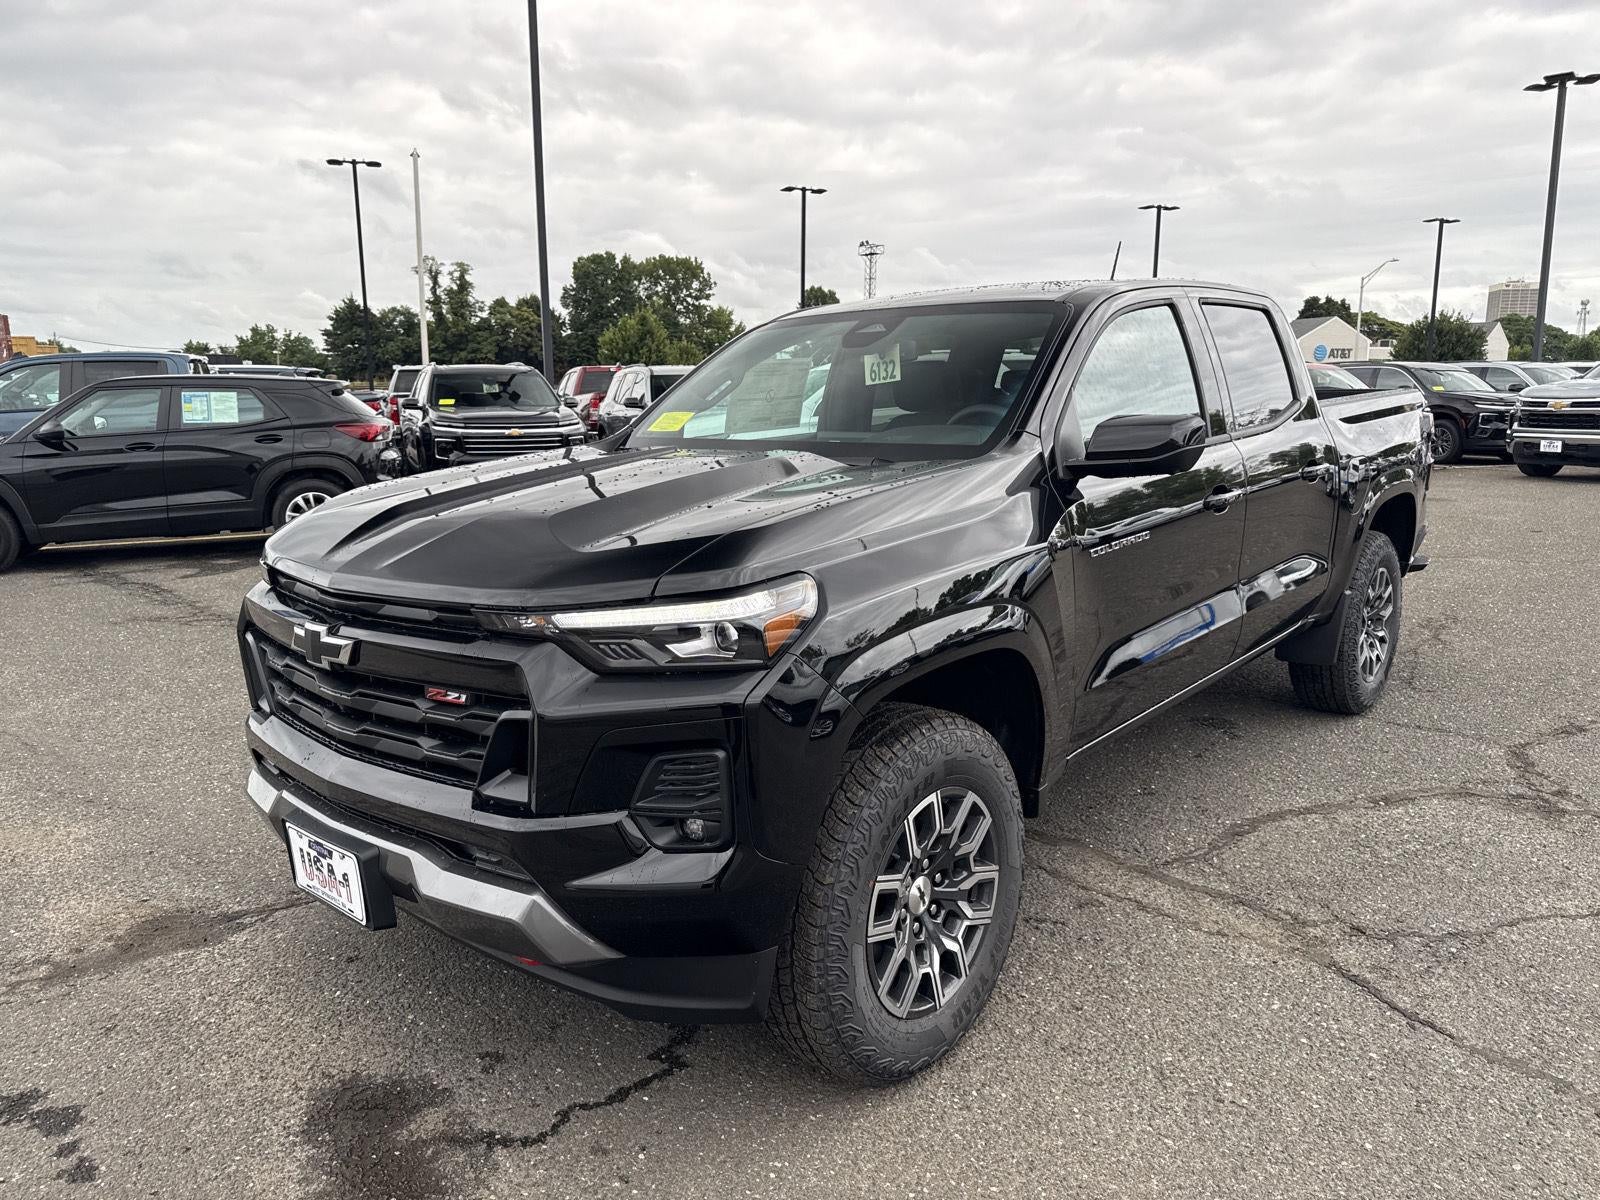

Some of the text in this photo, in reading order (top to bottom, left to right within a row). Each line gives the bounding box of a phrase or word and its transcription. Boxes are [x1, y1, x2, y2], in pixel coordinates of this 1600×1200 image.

[1328, 347, 1353, 359] AT&T
[869, 358, 897, 383] 6132
[1088, 530, 1151, 558] COLORADO
[426, 687, 467, 704] Z71
